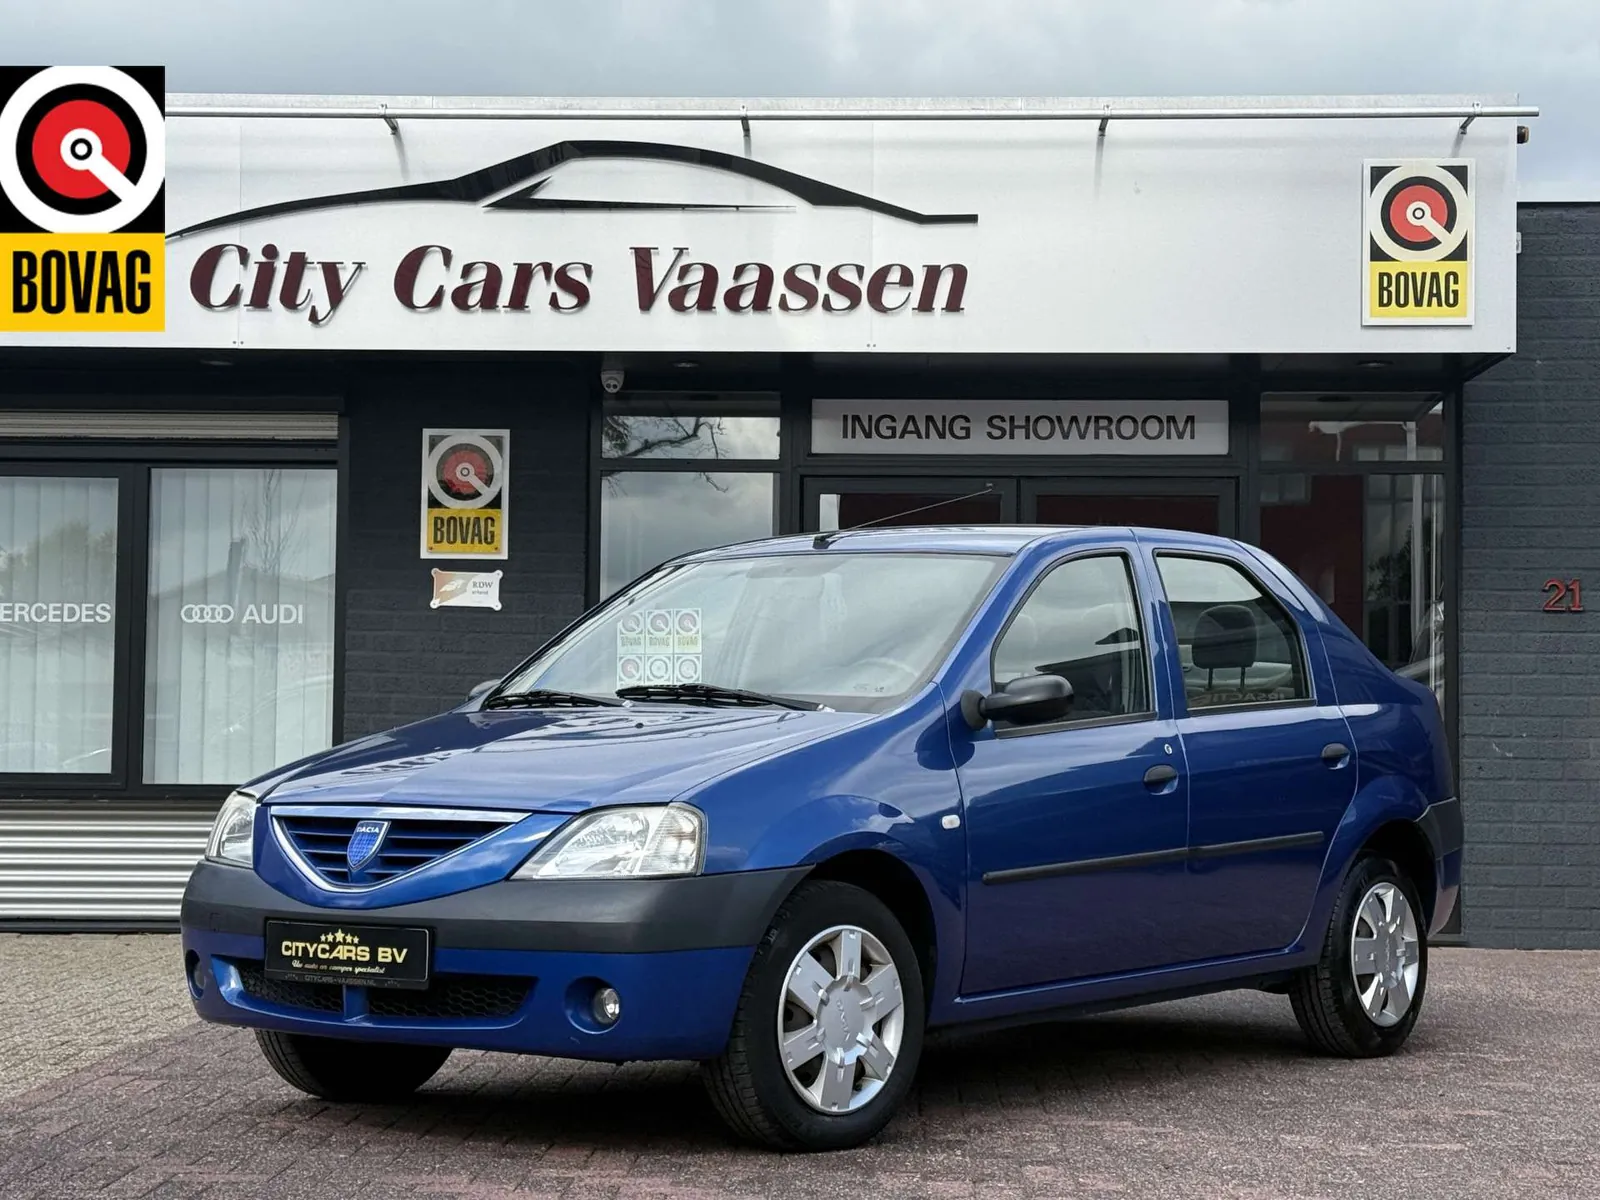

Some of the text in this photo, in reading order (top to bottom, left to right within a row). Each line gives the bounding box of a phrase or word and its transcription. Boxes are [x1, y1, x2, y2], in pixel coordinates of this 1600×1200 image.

[189, 243, 969, 325] City Cars Vaassen
[1377, 270, 1460, 309] BOVAG
[841, 413, 1197, 441] INGANG SHOWROOM
[432, 515, 496, 546] BOVAG
[472, 580, 494, 589] RDW
[1541, 577, 1584, 612] 21
[0, 602, 112, 624] ERCEDES
[241, 603, 304, 624] AUDI
[356, 826, 380, 834] DACIA
[281, 940, 408, 964] CITYCARS BV
[354, 966, 386, 975] specialist
